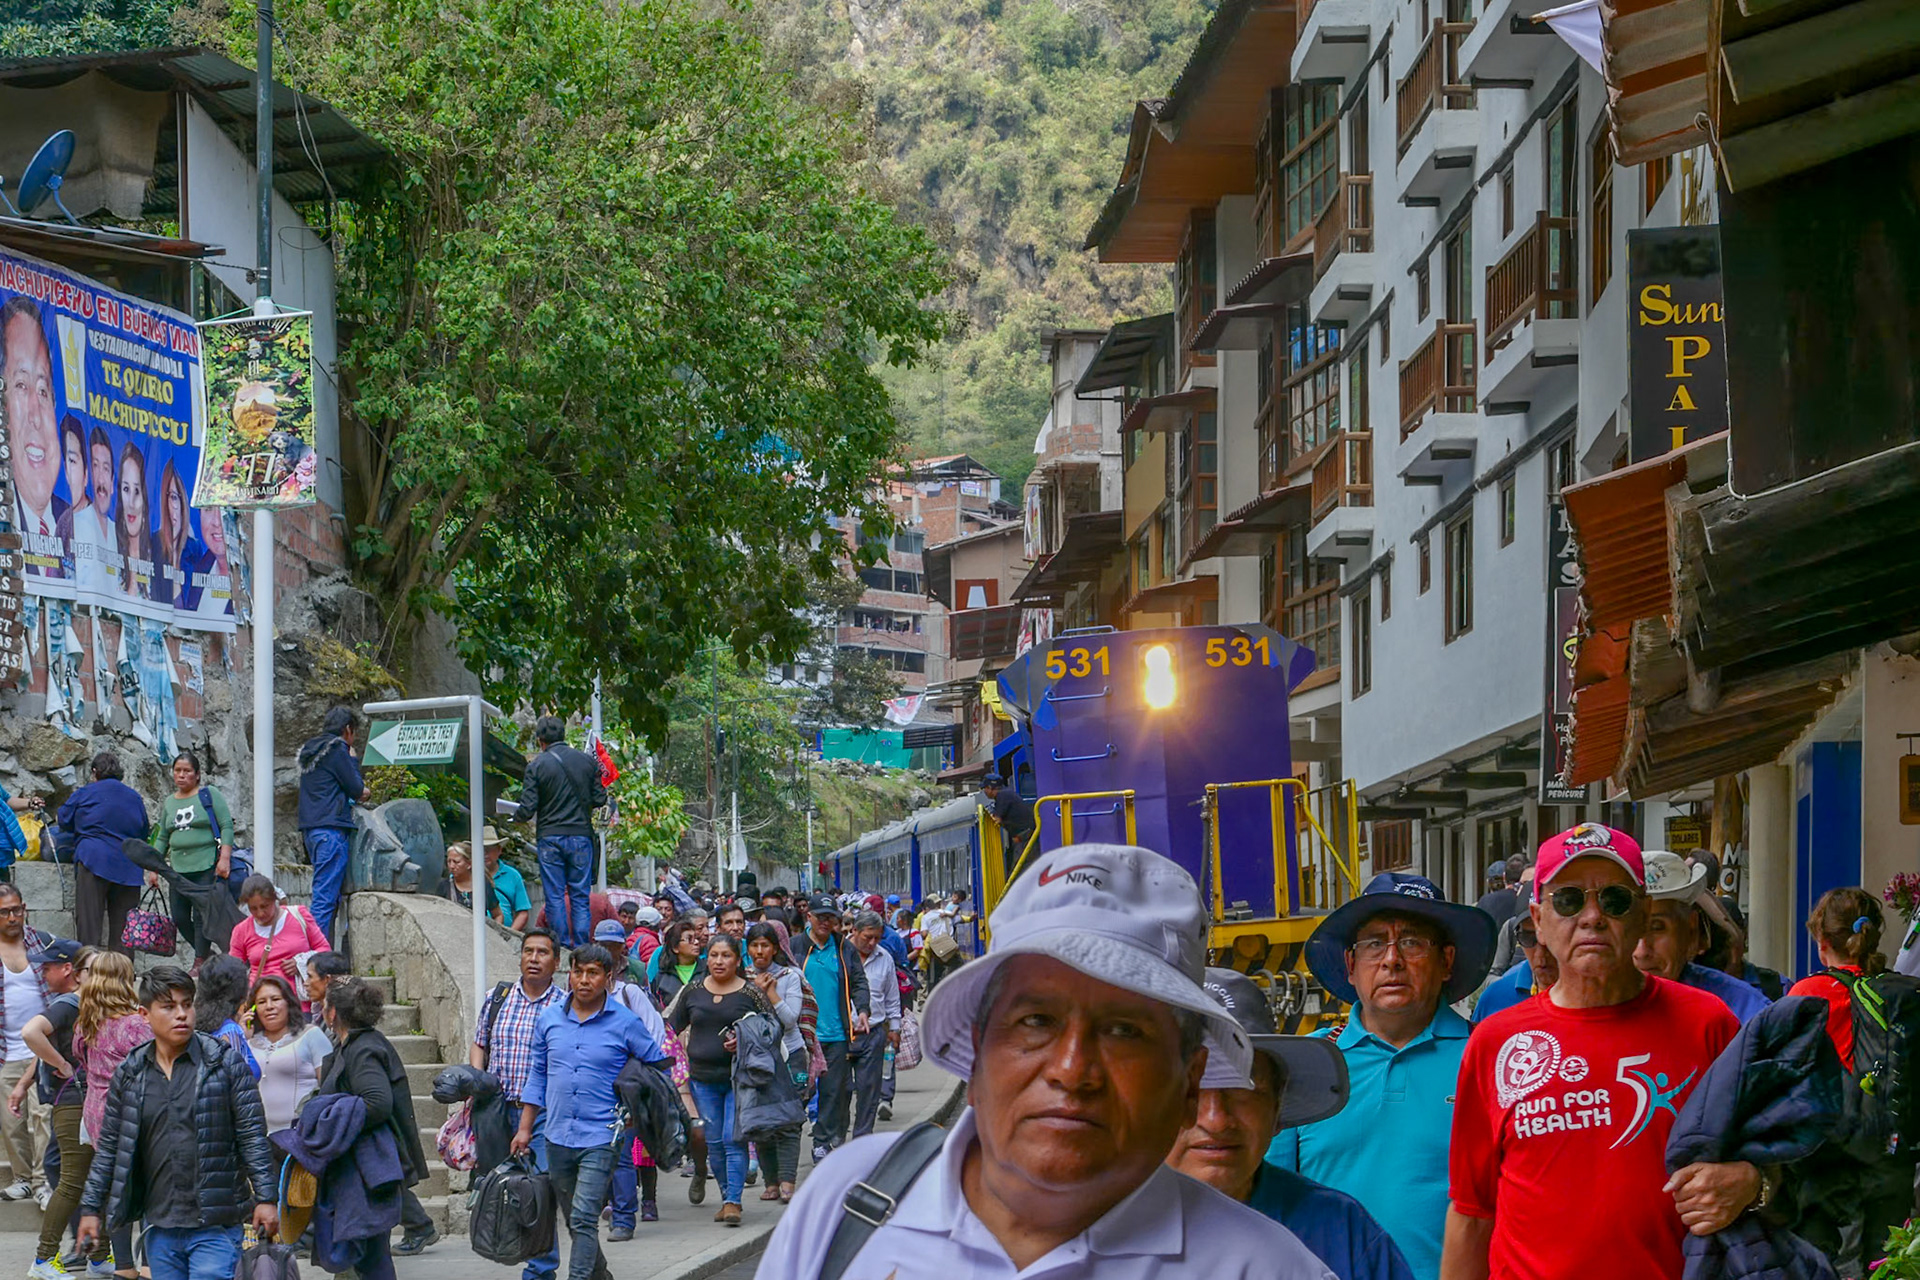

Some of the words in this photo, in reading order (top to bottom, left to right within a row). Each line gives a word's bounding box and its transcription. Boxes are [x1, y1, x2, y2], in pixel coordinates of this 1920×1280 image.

[96, 294, 119, 328] EN
[122, 304, 168, 348] BUENAS
[1639, 284, 1723, 327] Sun
[101, 359, 122, 388] TE
[1045, 646, 1110, 679] 531
[1206, 636, 1270, 667] 531
[427, 725, 438, 740] DE
[438, 724, 455, 739] TREN
[397, 743, 418, 756] TRAIN
[418, 741, 448, 755] STATION
[1547, 790, 1586, 799] PEDICURE
[1065, 872, 1103, 891] NIKE
[1515, 1094, 1557, 1119] RUN
[1563, 1088, 1610, 1108] FOR
[1514, 1107, 1612, 1139] HEALTH
